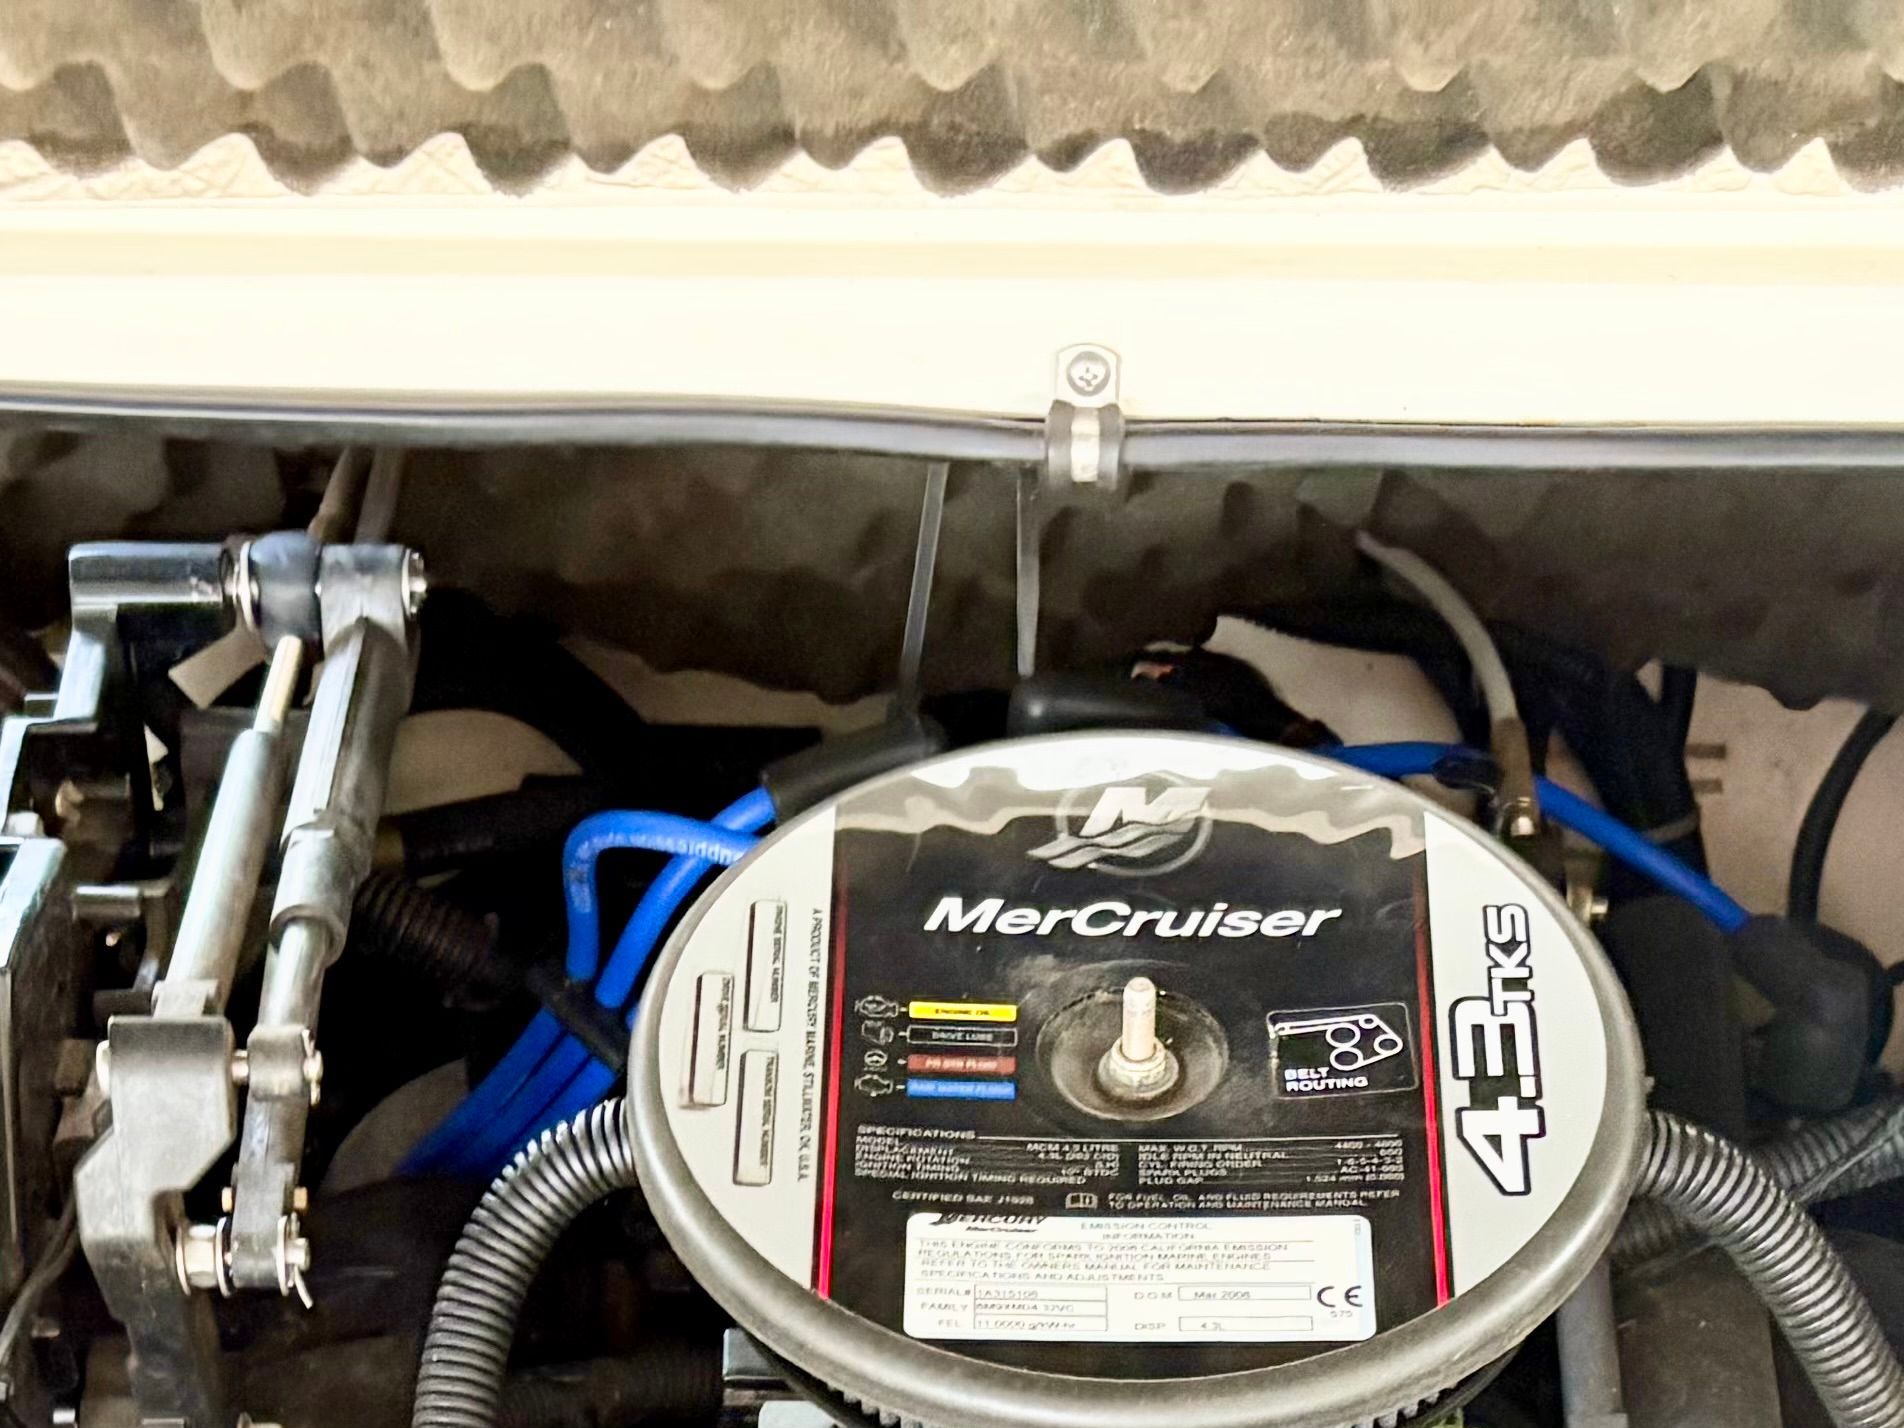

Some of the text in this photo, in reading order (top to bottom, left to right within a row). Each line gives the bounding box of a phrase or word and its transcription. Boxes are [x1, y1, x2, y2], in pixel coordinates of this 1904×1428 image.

[922, 897, 1343, 941] MerCruiser
[809, 918, 821, 963] PRODUCT
[1482, 903, 1532, 1014] TKS
[1284, 1069, 1328, 1082] BELT
[1285, 1077, 1368, 1092] ROUTING
[857, 1124, 976, 1140] SPECIFICATIONS
[1224, 1150, 1288, 1160] NEUTRAL
[892, 1190, 964, 1203] CERTIFIED
[1127, 1201, 1196, 1210] OPERATION
[1148, 1221, 1214, 1231] CONTROL
[1316, 1285, 1365, 1308] CE
[920, 1302, 969, 1312] FAMILY
